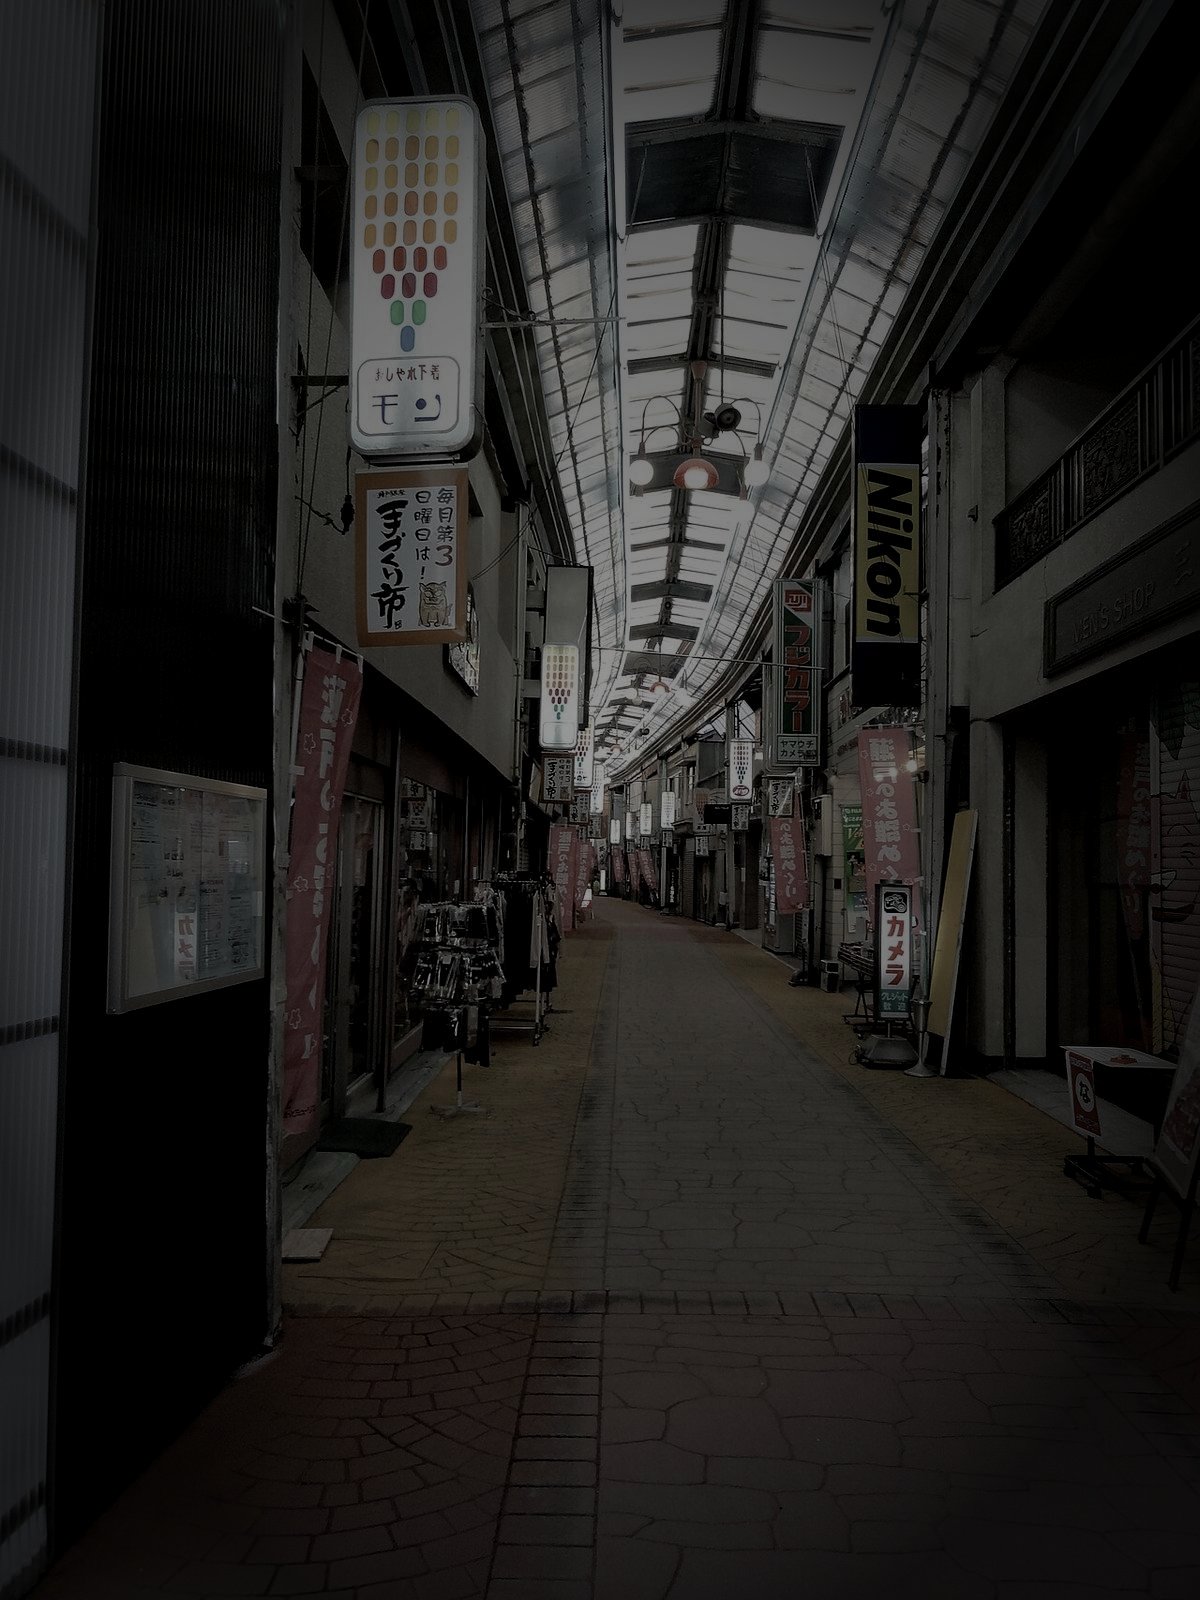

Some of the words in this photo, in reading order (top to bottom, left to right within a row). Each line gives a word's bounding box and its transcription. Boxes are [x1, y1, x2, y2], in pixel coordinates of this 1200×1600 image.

[371, 499, 409, 629] 手づくり市
[435, 487, 455, 567] 毎月第3
[866, 468, 914, 637] Nikon
[1114, 580, 1156, 624] SHOP
[784, 624, 811, 733] フジカラー
[780, 740, 815, 749] ヤマウチ
[885, 915, 905, 986] カメラ
